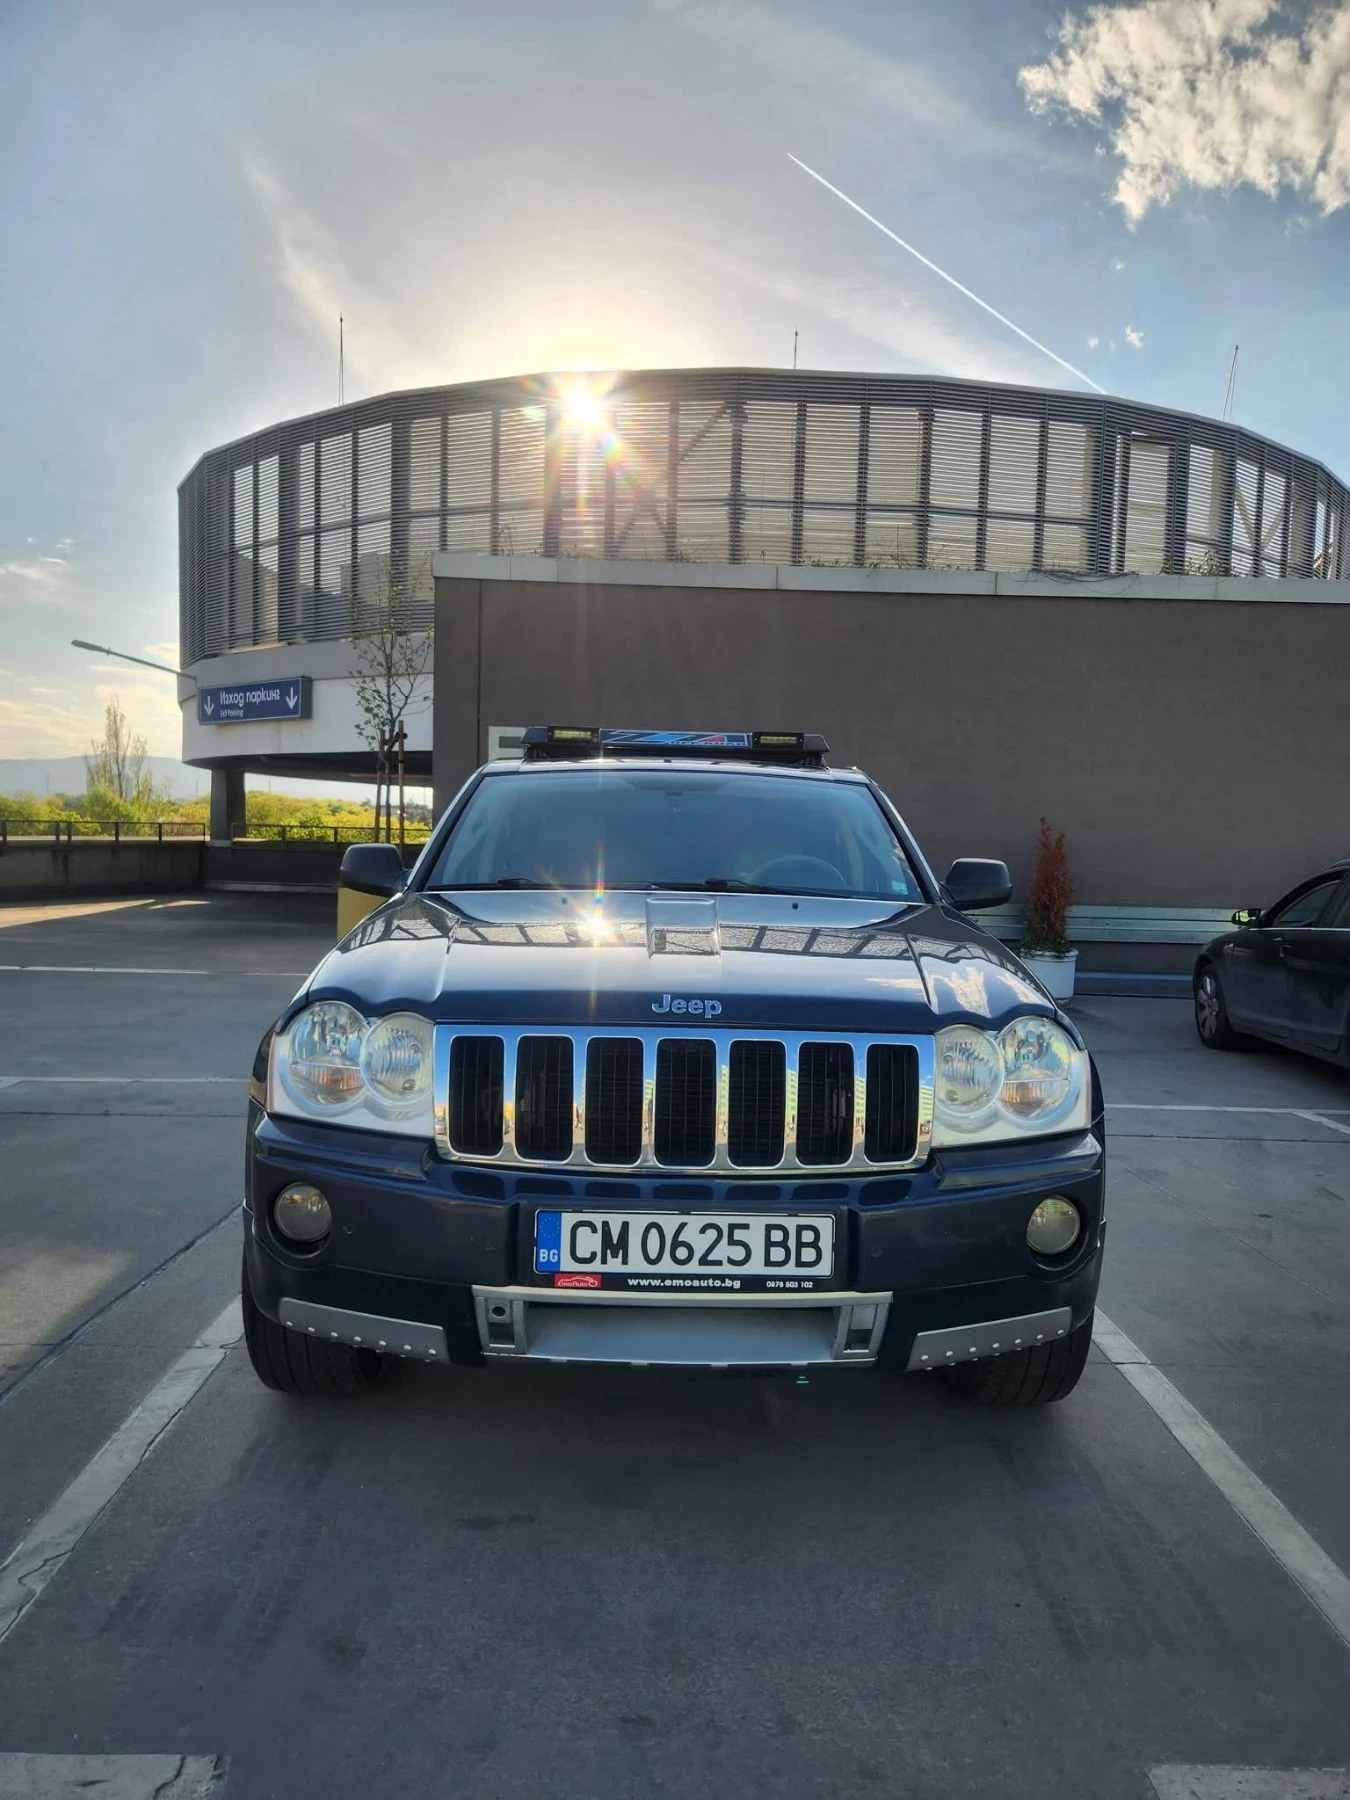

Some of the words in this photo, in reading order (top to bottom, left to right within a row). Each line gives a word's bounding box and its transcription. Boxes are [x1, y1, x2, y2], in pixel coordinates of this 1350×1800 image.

[220, 690, 244, 707] Изход
[246, 687, 280, 705] паркинг
[651, 994, 722, 1018] Jeep
[569, 1220, 630, 1265] CM
[641, 1221, 752, 1267] 0625
[763, 1223, 823, 1268] BB
[539, 1249, 559, 1263] BG
[627, 1277, 741, 1289] www.emoauto.bg
[801, 1281, 814, 1289] 102
